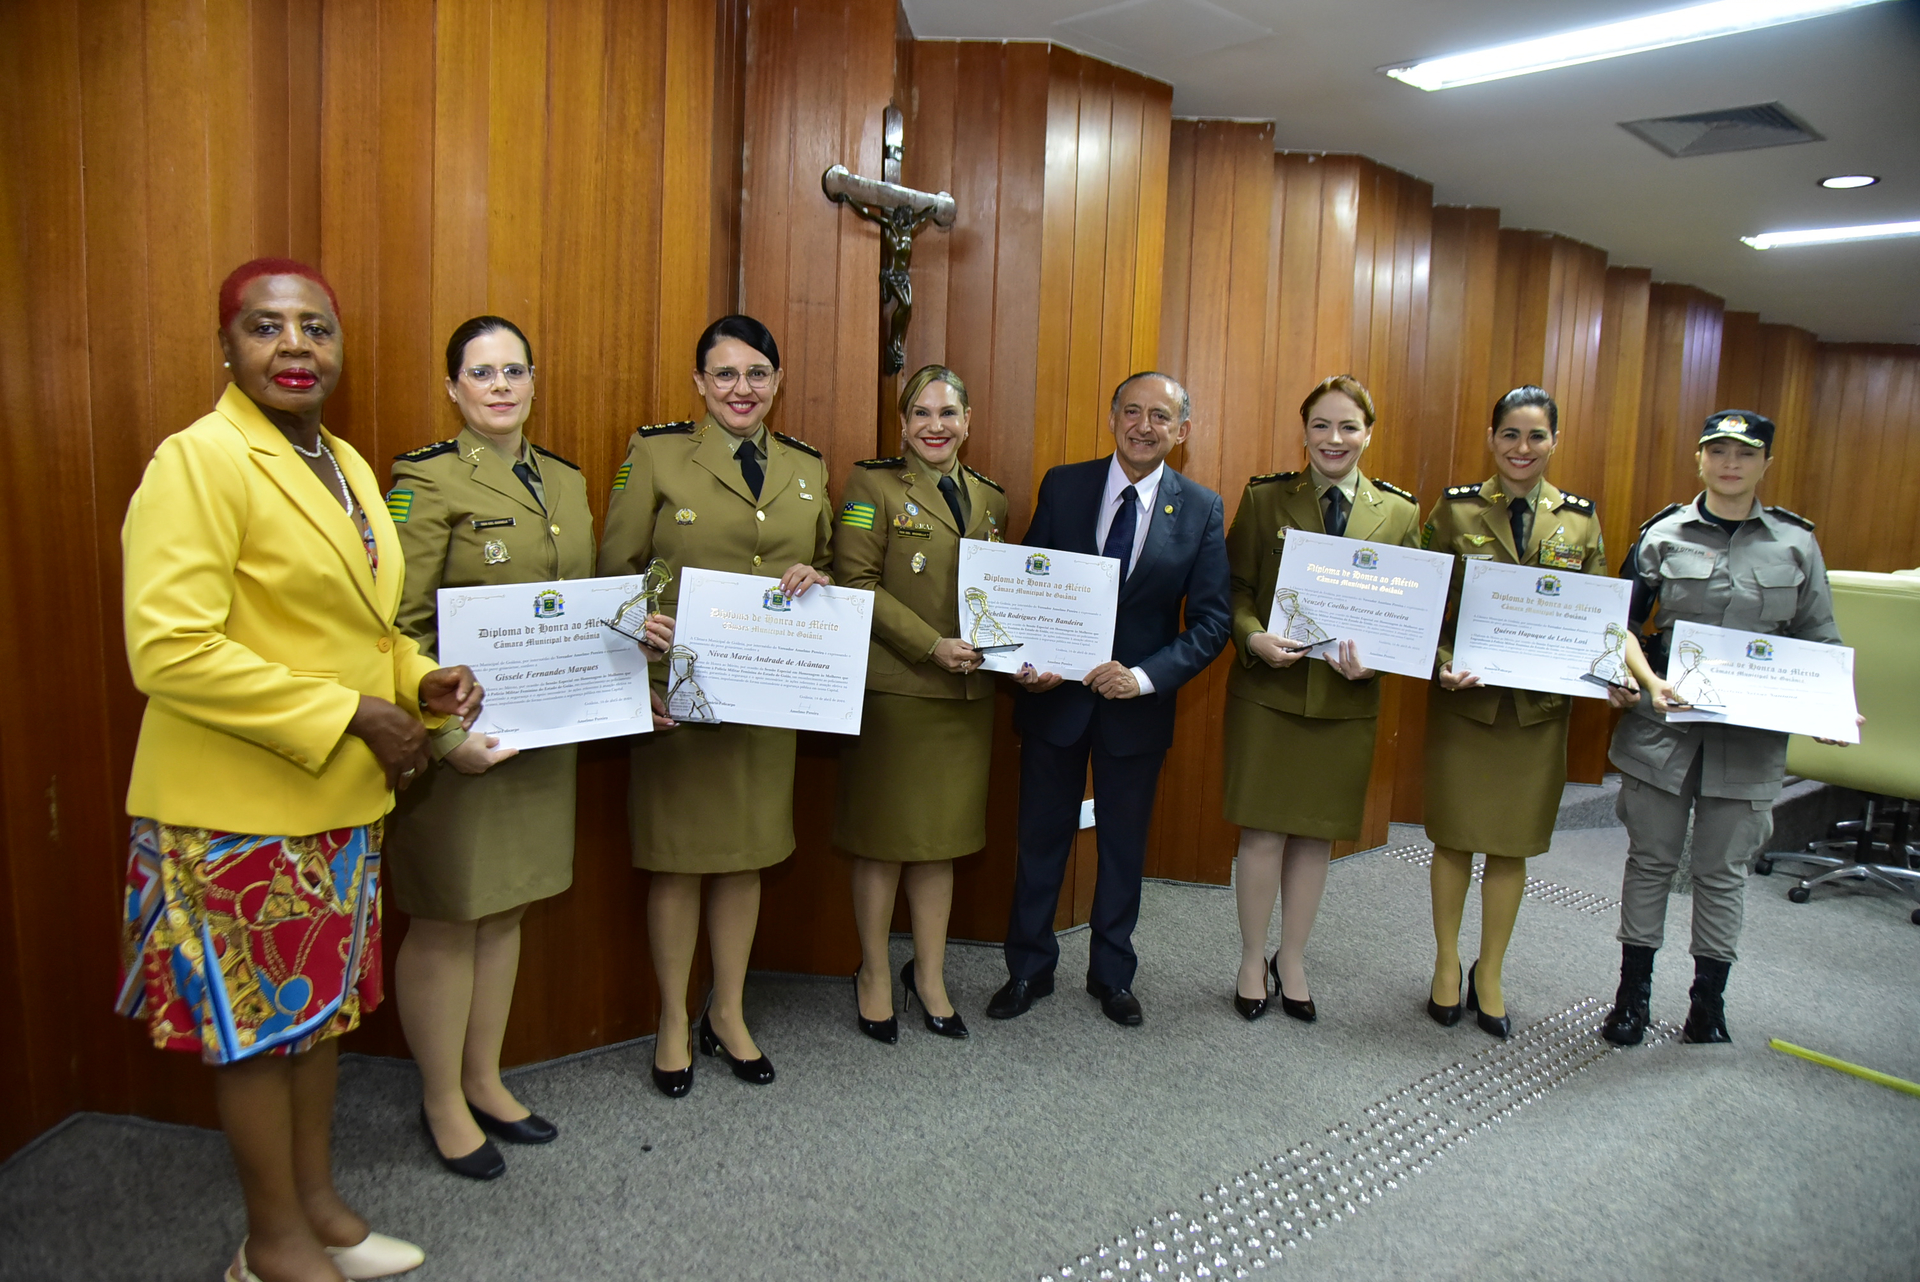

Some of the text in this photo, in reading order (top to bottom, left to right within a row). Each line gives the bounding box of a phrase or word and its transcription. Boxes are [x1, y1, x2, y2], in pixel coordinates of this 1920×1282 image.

[984, 573, 1015, 585] Diploma
[1027, 578, 1051, 589] Honra
[1064, 582, 1091, 594] Mérito
[993, 584, 1014, 593] Câmara
[1016, 588, 1044, 597] Municipal
[1054, 592, 1077, 601] Goiânia
[1492, 592, 1524, 604] Diploma
[1537, 598, 1562, 609] Honra
[1574, 602, 1602, 615] Mérito
[710, 608, 749, 622] Diploma
[752, 614, 761, 623] de
[764, 614, 793, 627] Honra
[808, 618, 839, 632] Mérito
[1008, 612, 1036, 622] Rodrigues
[1056, 618, 1083, 626] Bandeira
[478, 625, 522, 640] Diploma
[525, 625, 535, 634] de
[538, 621, 568, 634] Honra
[494, 638, 523, 649] Câmara
[525, 636, 562, 647] Municipal
[573, 631, 600, 642] Goiânia
[708, 650, 729, 658] Nívea
[730, 652, 752, 661] Maria
[754, 655, 784, 664] Andrade
[796, 659, 830, 669] Alcântara
[496, 664, 599, 682] Gissele Fernandes Marques
